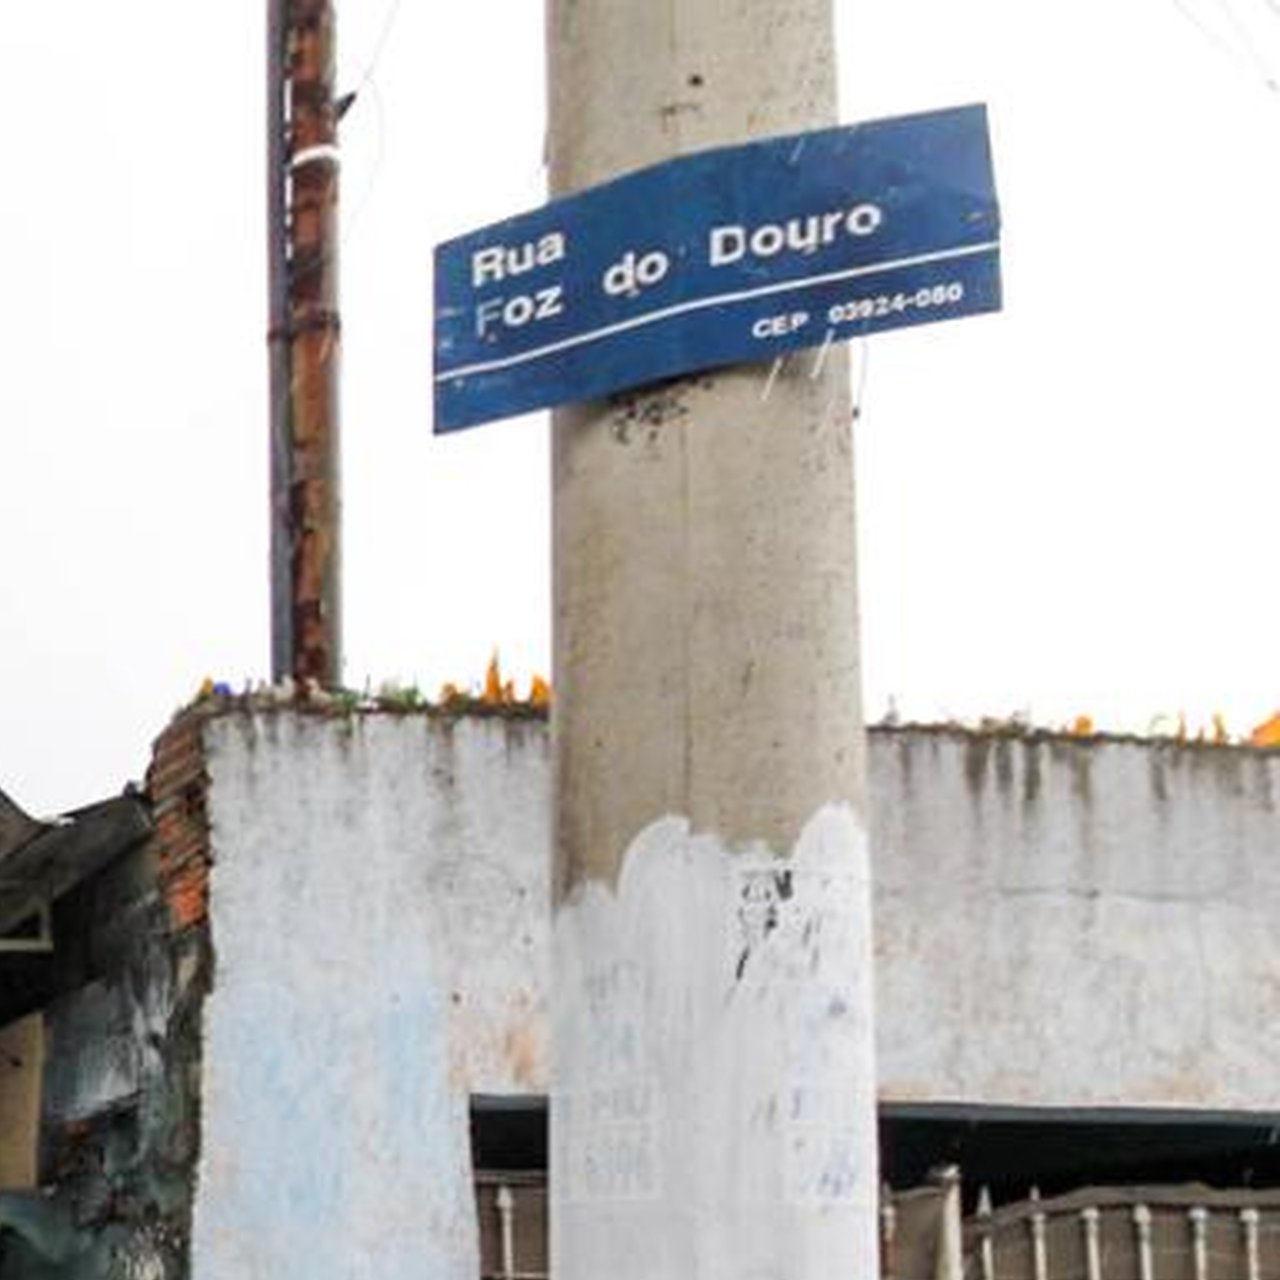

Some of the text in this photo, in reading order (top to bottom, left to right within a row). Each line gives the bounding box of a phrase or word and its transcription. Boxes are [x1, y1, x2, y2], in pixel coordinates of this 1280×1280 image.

[472, 232, 566, 286] Rua
[475, 203, 882, 339] Foz do Douro
[752, 310, 810, 339] CEP
